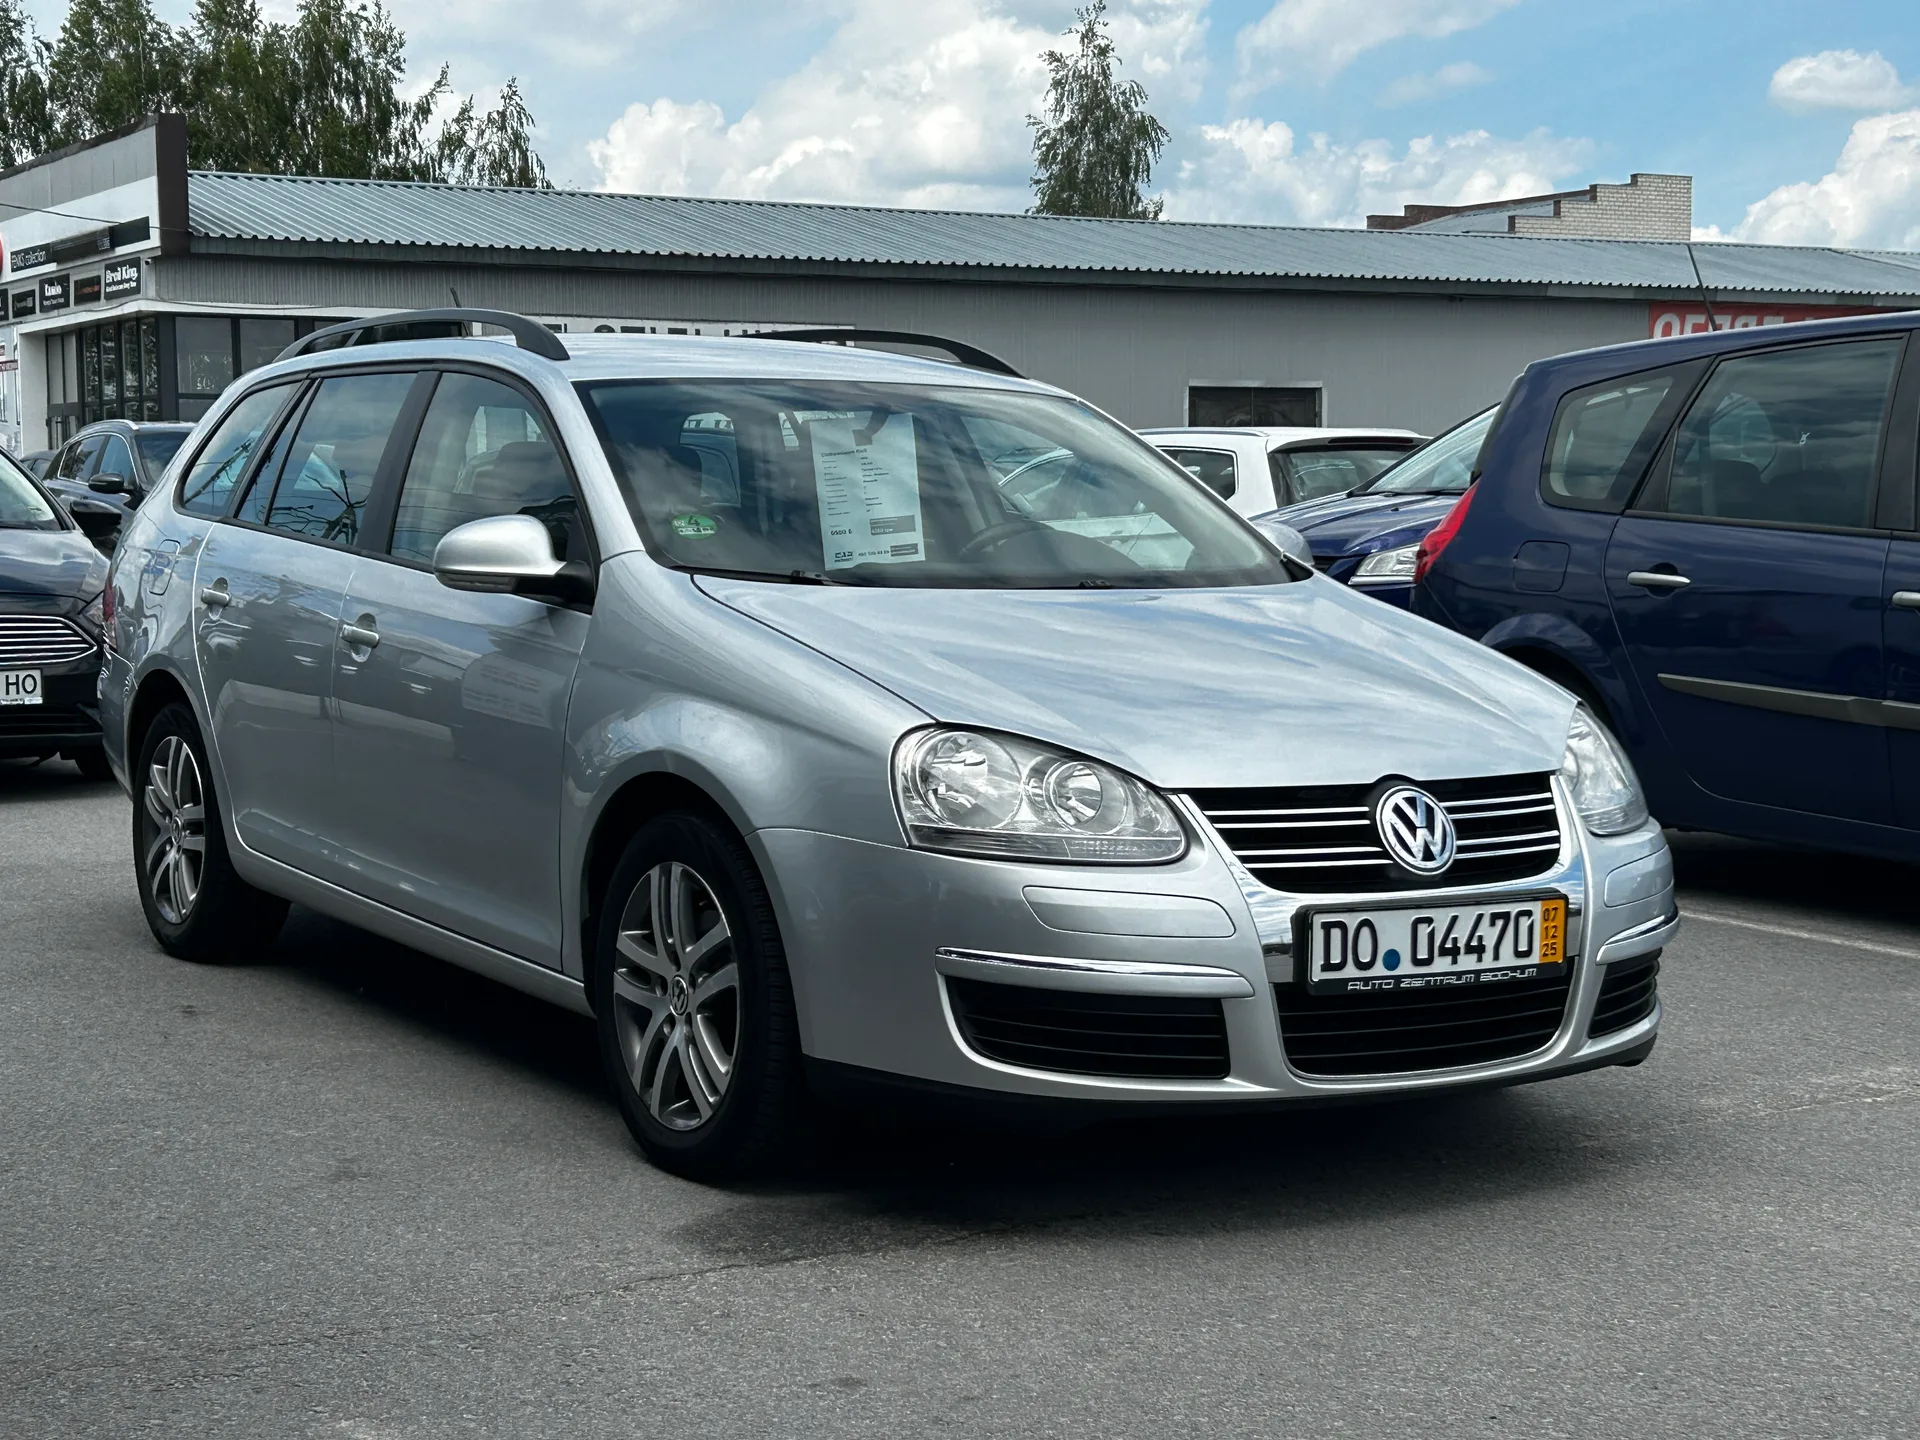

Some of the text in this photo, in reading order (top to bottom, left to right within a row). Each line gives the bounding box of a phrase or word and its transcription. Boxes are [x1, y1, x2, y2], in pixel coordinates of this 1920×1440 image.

[106, 264, 138, 283] Broil King
[5, 674, 37, 695] HO
[1543, 907, 1559, 921] 07
[1320, 909, 1535, 972] DO 04470
[1544, 925, 1557, 939] 12
[1541, 942, 1557, 956] 25
[1347, 968, 1537, 991] AUTO ZENTRUM BOCHUM
